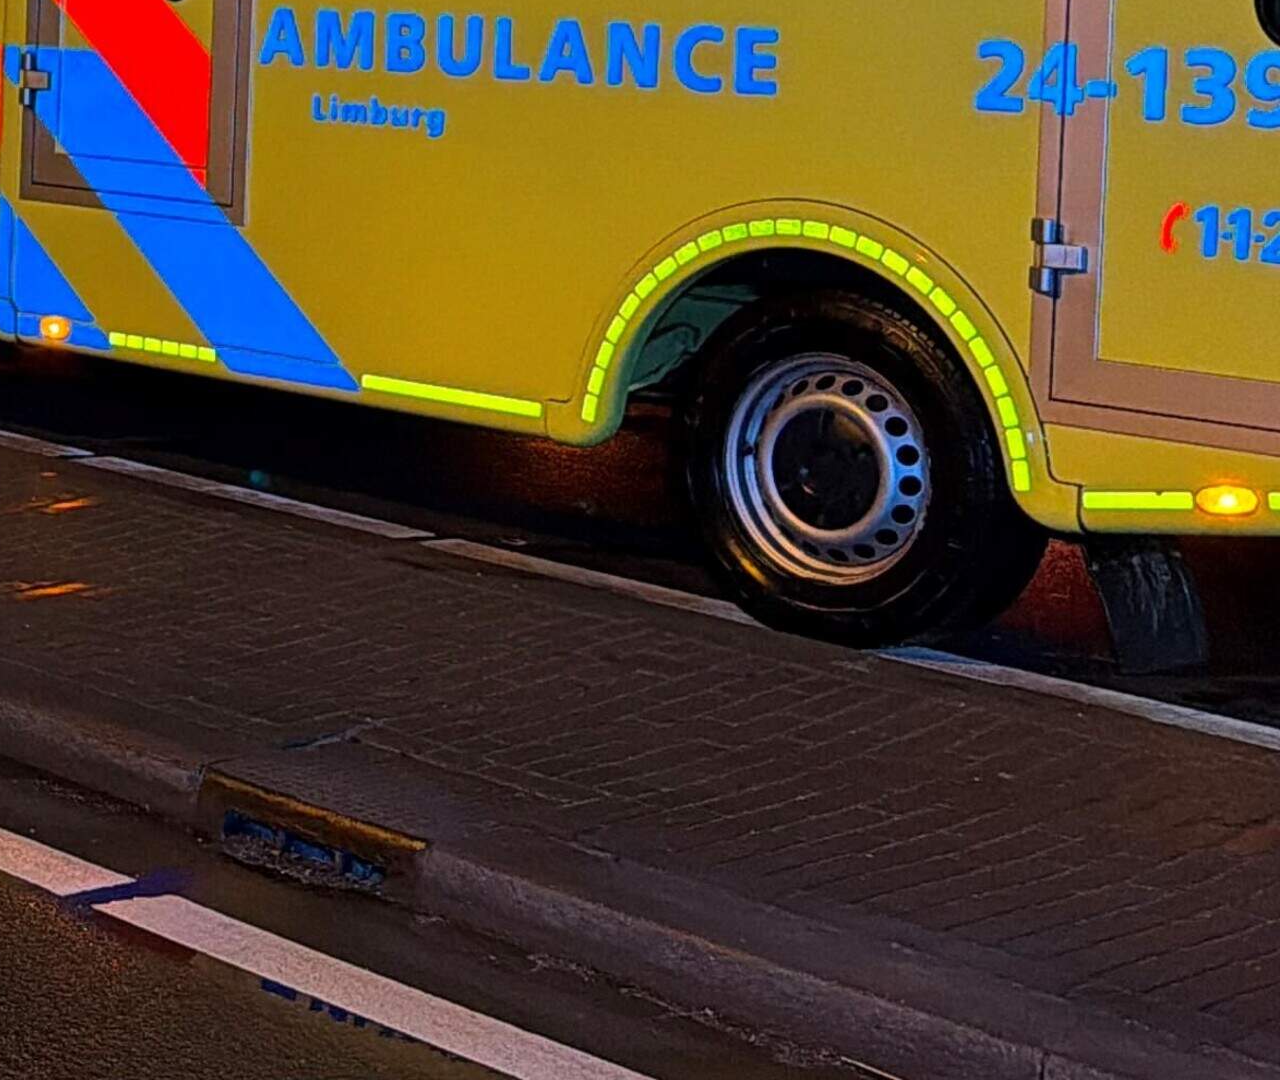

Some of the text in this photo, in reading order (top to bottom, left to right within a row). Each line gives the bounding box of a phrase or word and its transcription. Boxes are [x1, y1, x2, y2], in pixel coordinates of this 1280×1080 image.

[259, 7, 779, 95] AMBULANCE
[975, 39, 1280, 129] 24-139
[312, 94, 446, 138] Limburg
